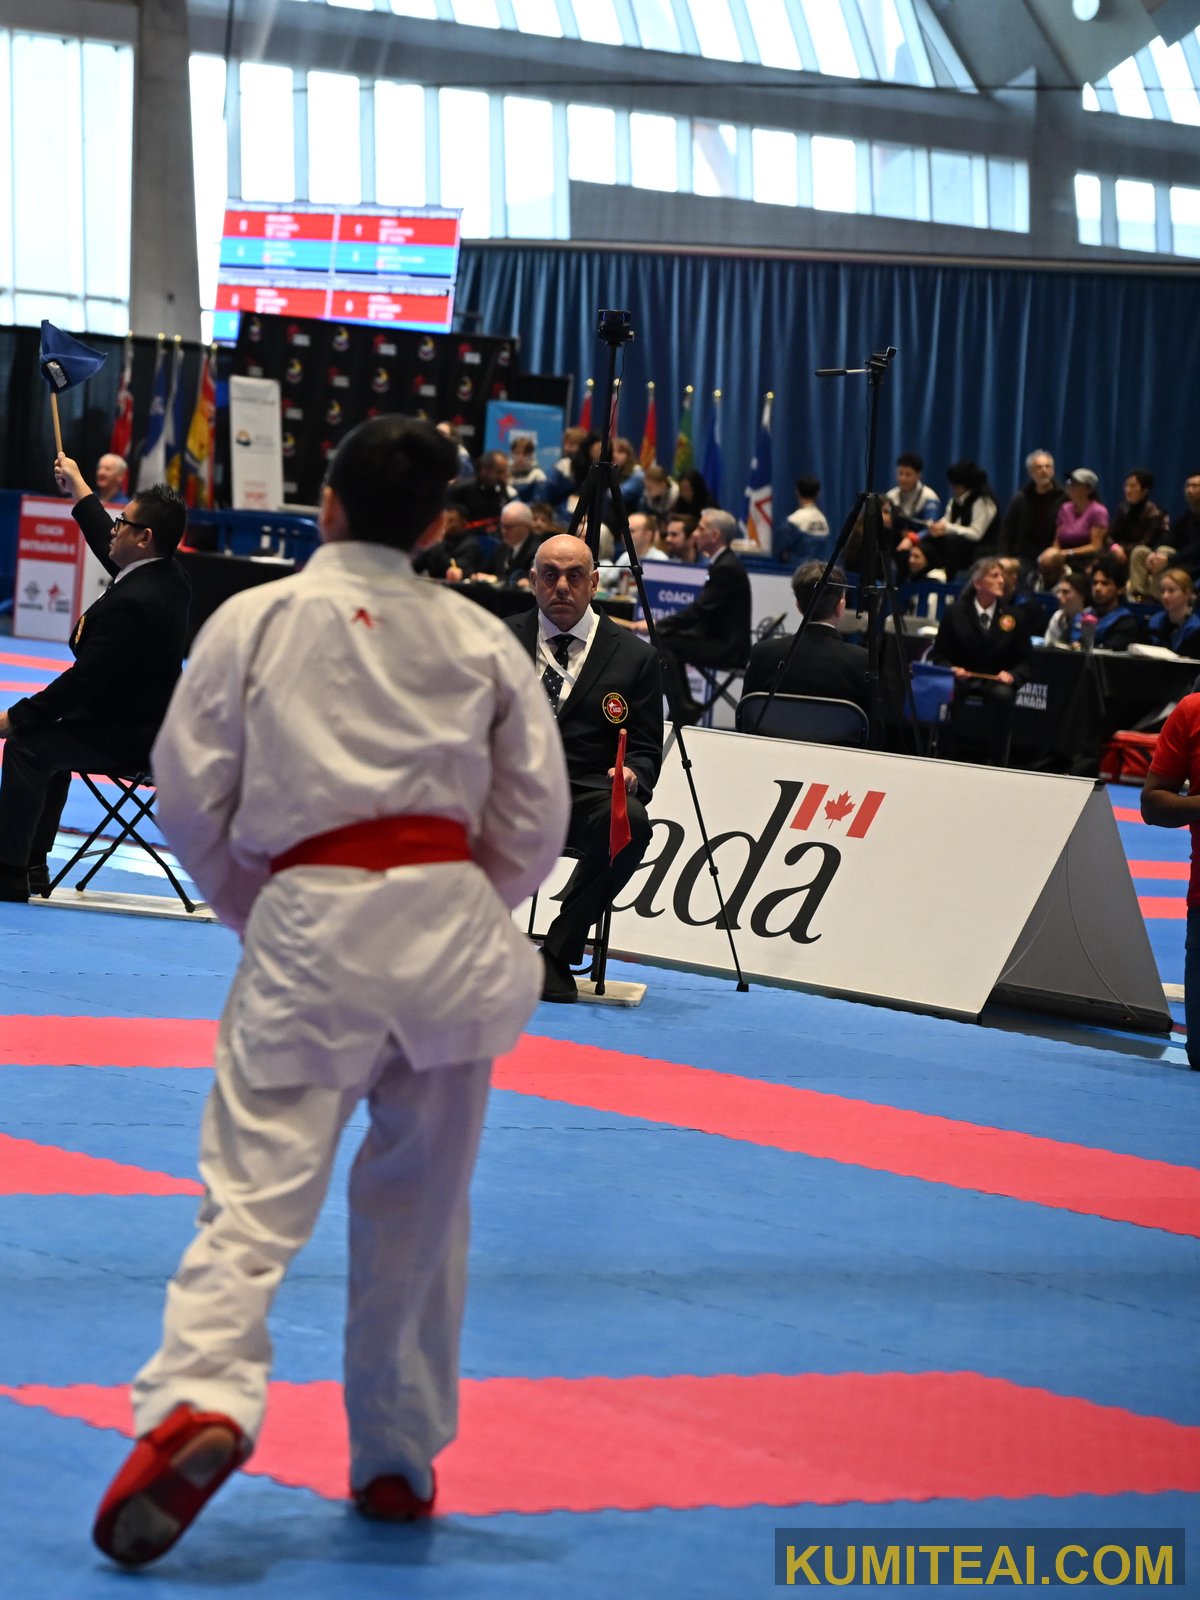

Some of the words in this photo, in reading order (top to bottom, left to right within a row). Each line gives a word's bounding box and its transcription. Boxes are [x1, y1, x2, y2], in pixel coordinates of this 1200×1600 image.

[658, 589, 695, 604] COACH
[1018, 682, 1048, 697] ARATE
[1015, 693, 1047, 711] ANADA
